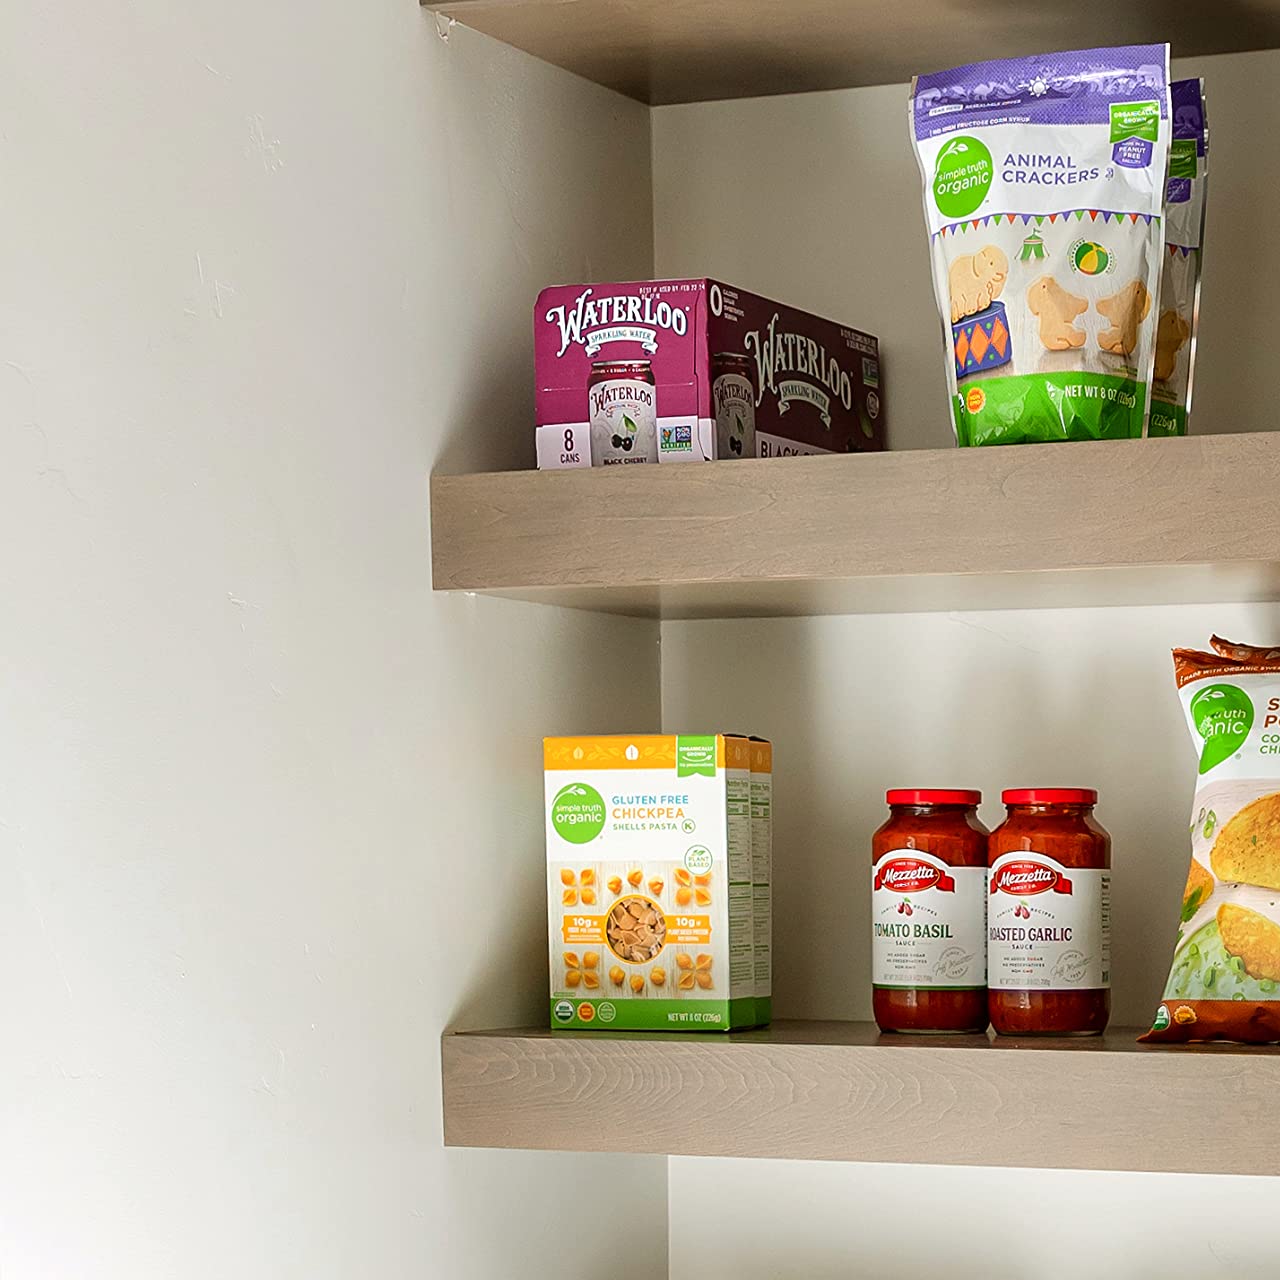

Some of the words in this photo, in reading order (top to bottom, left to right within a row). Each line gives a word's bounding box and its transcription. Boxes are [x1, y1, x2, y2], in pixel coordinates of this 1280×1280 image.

[957, 119, 989, 130] FRUCTOSE
[989, 117, 1008, 125] CORN
[1003, 153, 1077, 168] ANIMAL
[938, 168, 966, 182] simple
[966, 159, 988, 173] truth
[1002, 167, 1099, 185] CRACKERS
[937, 171, 989, 195] organic
[710, 284, 723, 317] 0
[545, 288, 688, 357] WATERLOO
[590, 329, 628, 343] SPARKLING
[629, 330, 652, 341] WATER
[744, 313, 852, 410] WATERLOO
[1064, 385, 1083, 398] NET
[1084, 385, 1098, 398] WT
[1100, 387, 1106, 399] 8
[1107, 389, 1117, 401] OZ
[590, 384, 653, 418] WATERLOO
[1151, 413, 1177, 430] (226g)
[564, 429, 574, 452] 8
[560, 453, 581, 464] CANS
[603, 457, 623, 466] BLACK
[624, 456, 648, 465] CHERRY
[1184, 670, 1201, 682] MADE
[1202, 667, 1223, 675] WITH
[1223, 665, 1259, 673] ORGANIC
[612, 795, 657, 805] GLUTEN
[660, 795, 689, 804] FREE
[556, 805, 581, 814] simple
[581, 804, 602, 812] truth
[612, 807, 685, 819] CHICKPEA
[556, 812, 602, 825] organic
[613, 823, 646, 831] SHELLS
[881, 866, 934, 884] Mezzetta
[998, 869, 1052, 887] Mezzetta
[913, 904, 938, 917] RECIPES
[1030, 907, 1055, 920] RECIPES
[573, 917, 592, 928] 10g
[675, 917, 695, 928] 10g
[874, 922, 910, 938] TOMATO
[913, 923, 954, 939] BASIL
[1028, 927, 1073, 942] GARLIC
